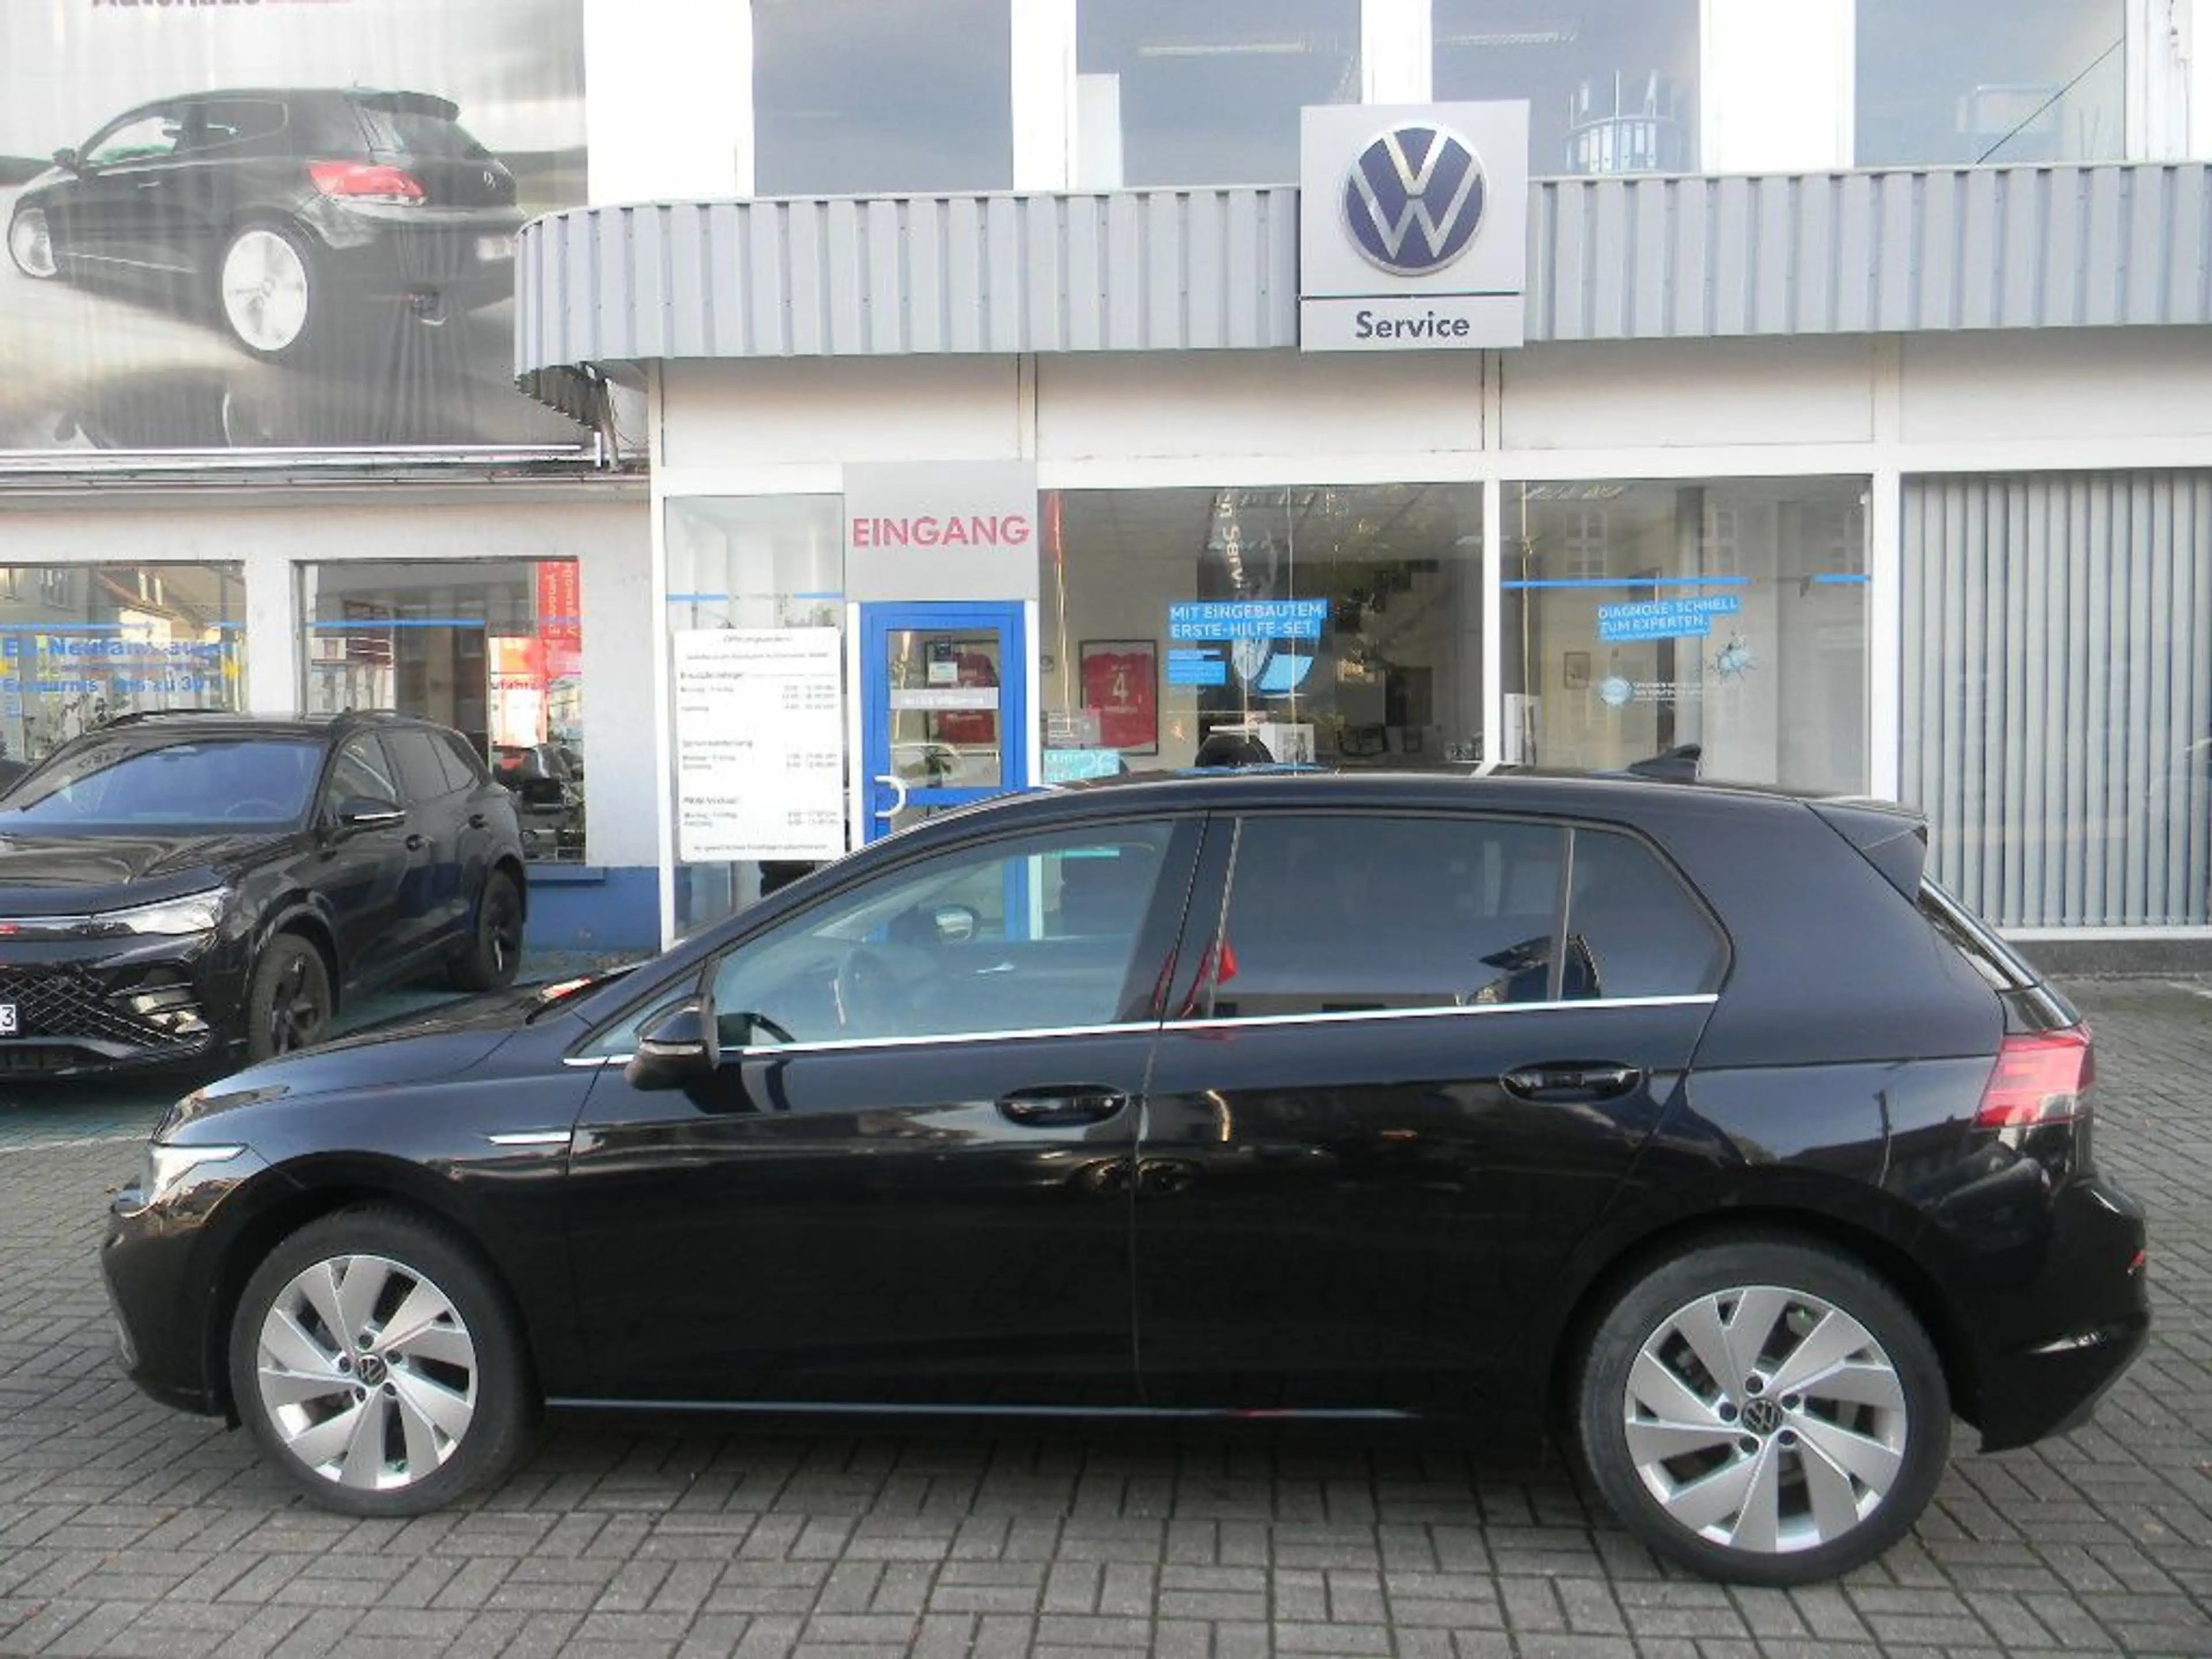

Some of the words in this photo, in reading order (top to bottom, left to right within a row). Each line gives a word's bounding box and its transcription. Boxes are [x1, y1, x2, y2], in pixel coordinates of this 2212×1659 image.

[1355, 310, 1470, 339] Service
[853, 516, 1031, 547] EINGANG
[1171, 607, 1201, 620] MIT
[2, 1006, 14, 1027] 3
